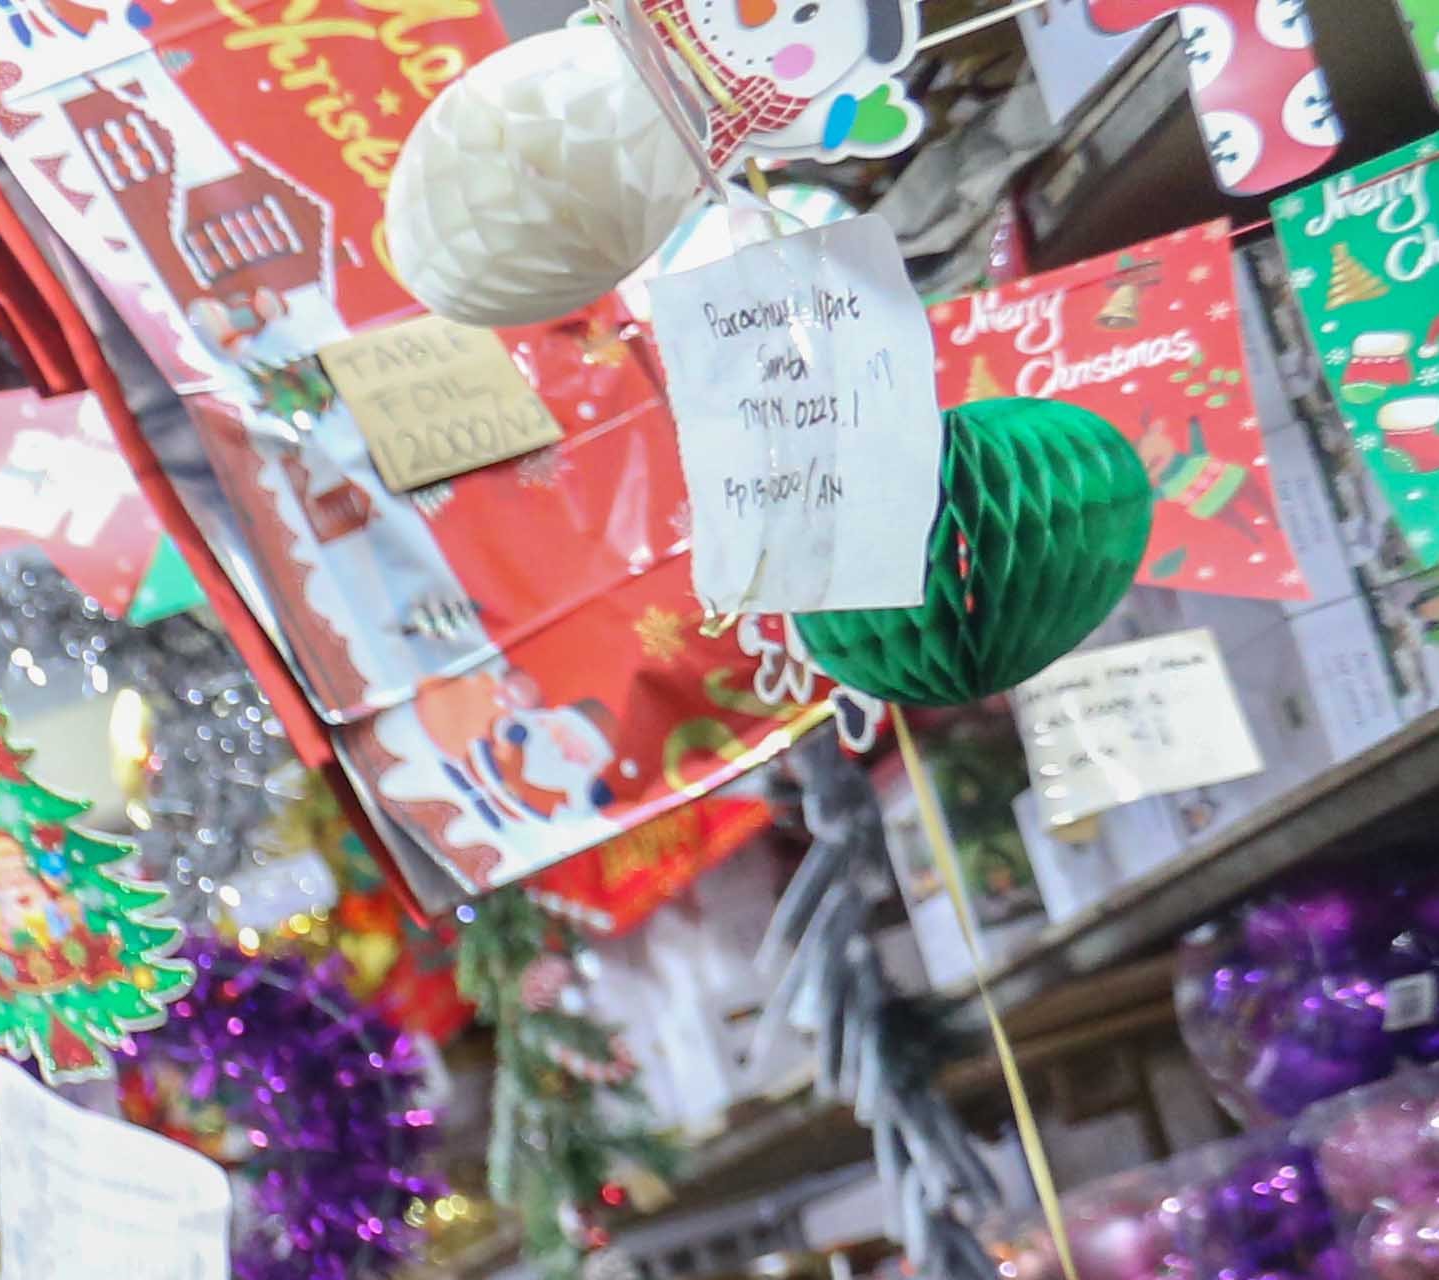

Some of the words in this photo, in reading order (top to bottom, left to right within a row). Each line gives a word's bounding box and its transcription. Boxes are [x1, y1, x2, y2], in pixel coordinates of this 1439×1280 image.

[1304, 163, 1430, 237] Merry
[336, 326, 476, 380] TABLE
[950, 288, 1066, 355] Merry
[1015, 328, 1202, 400] Christmas
[366, 374, 502, 426] FOIL
